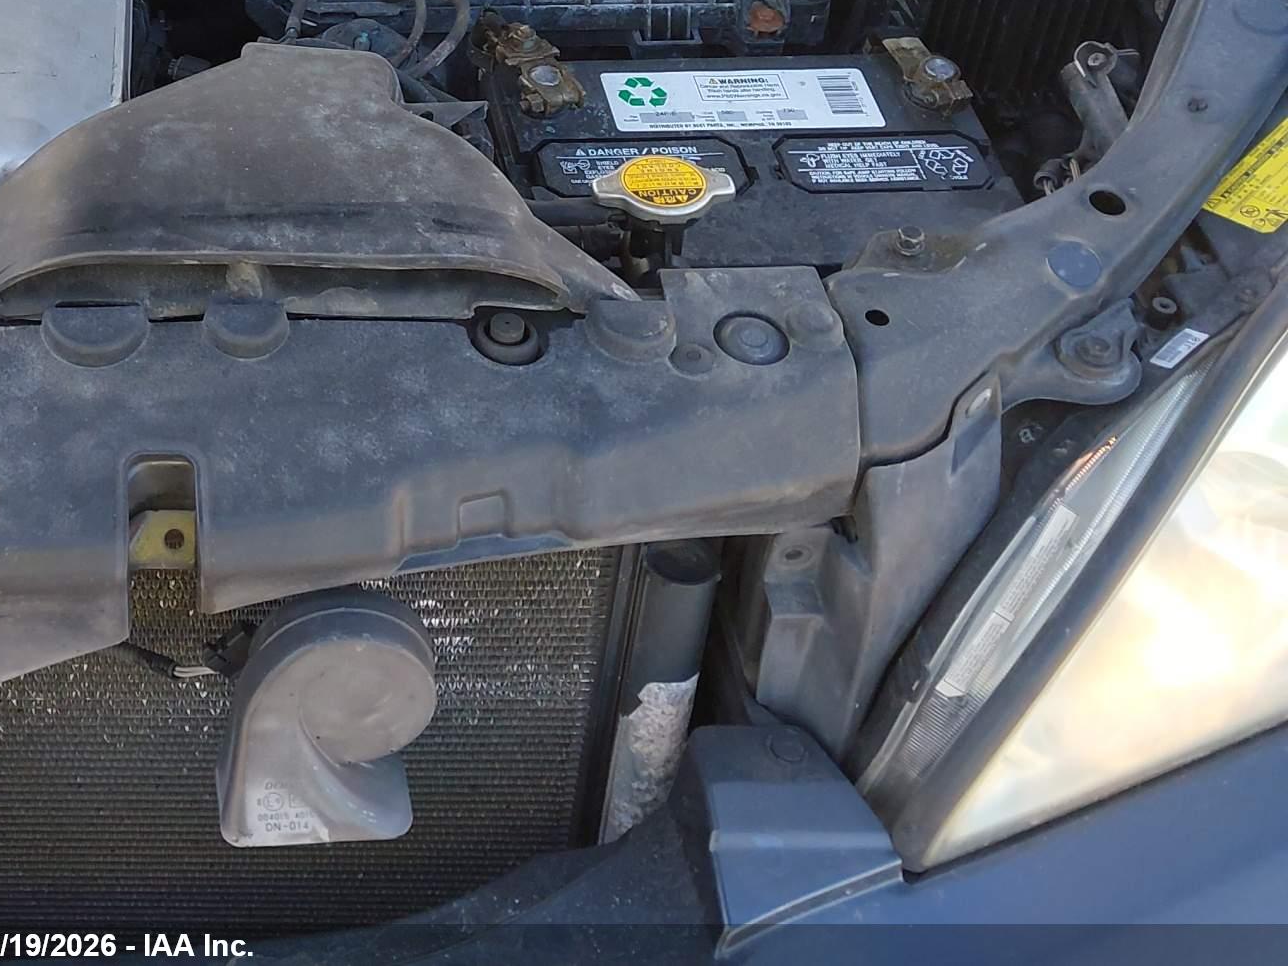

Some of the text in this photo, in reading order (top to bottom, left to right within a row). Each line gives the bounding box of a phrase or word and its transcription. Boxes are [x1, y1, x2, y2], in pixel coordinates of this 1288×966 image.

[717, 77, 769, 85] WARNING:
[588, 147, 639, 156] DANGER
[651, 146, 698, 155] POISON
[638, 187, 697, 198] CAUTION
